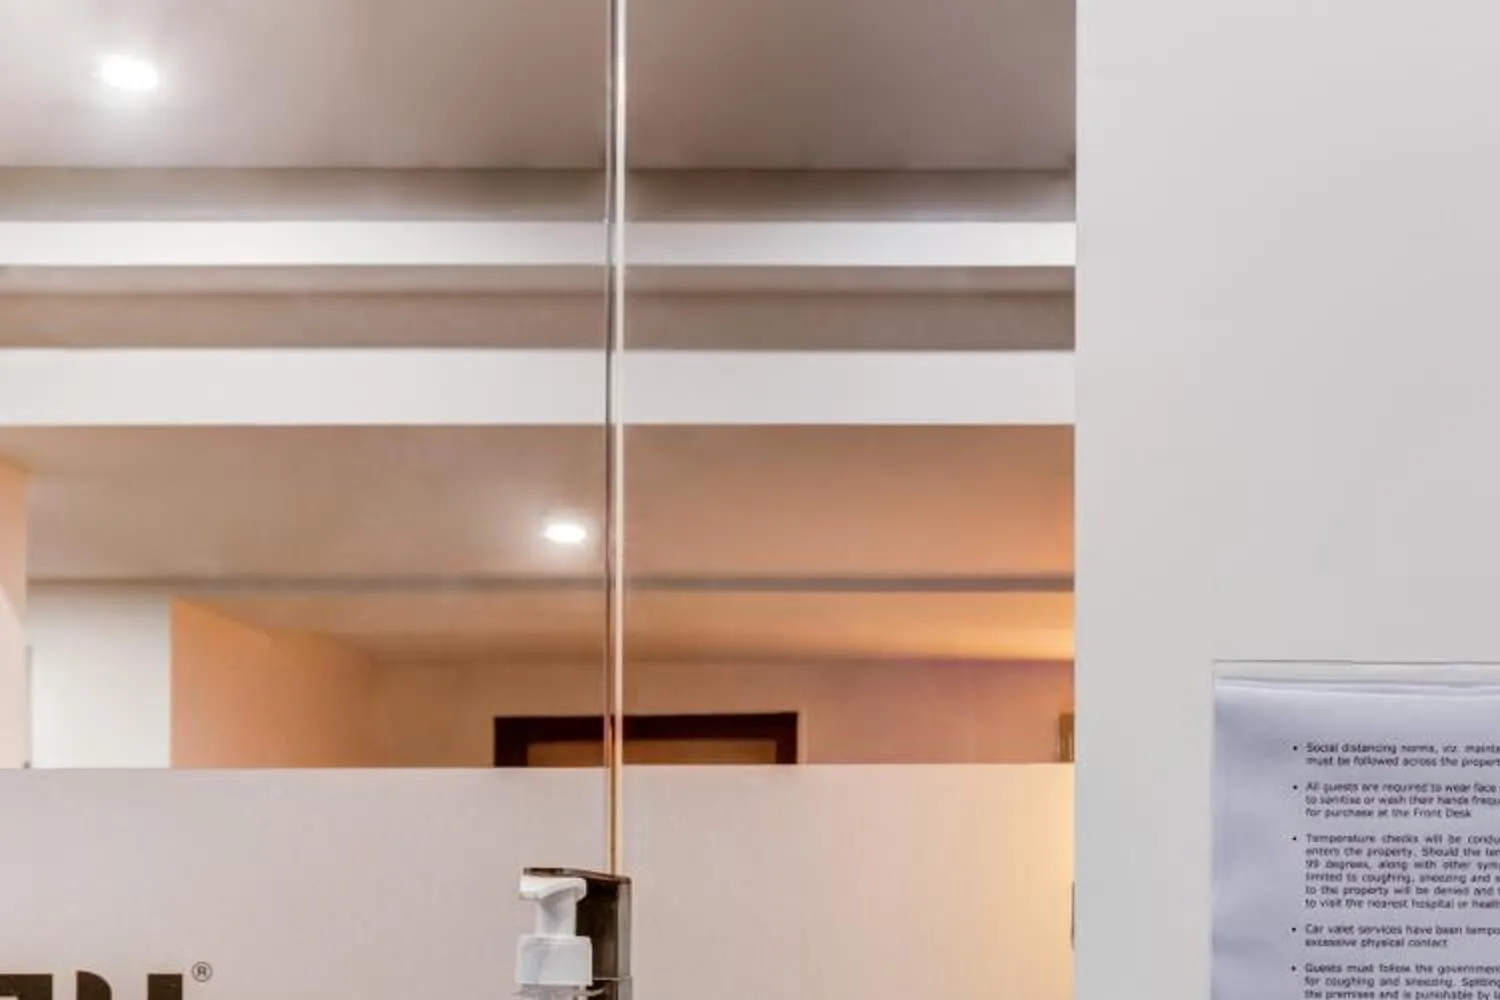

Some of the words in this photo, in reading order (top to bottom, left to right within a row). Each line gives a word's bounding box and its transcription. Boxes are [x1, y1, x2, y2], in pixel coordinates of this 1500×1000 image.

[1305, 742, 1339, 753] Social
[1340, 743, 1397, 756] distancing
[1336, 755, 1350, 766] be
[1352, 755, 1399, 767] followed
[1401, 758, 1438, 767] across
[1438, 756, 1458, 767] the
[1321, 781, 1359, 795] guests
[1360, 783, 1379, 792] are
[1429, 782, 1442, 793] to
[1472, 782, 1497, 793] face
[1304, 794, 1317, 805] to
[1362, 796, 1375, 805] or
[1377, 794, 1406, 805] wash
[1436, 795, 1469, 806] hands
[1304, 807, 1321, 818] for
[1323, 807, 1374, 820] purchase
[1376, 807, 1388, 818] at
[1390, 807, 1410, 818] the
[1412, 807, 1442, 818] Front
[1444, 807, 1471, 818] Desk
[1380, 833, 1419, 844] checks
[1446, 833, 1462, 844] be
[1343, 846, 1362, 857] the
[1420, 846, 1459, 857] Should
[1462, 846, 1481, 857] the
[1377, 858, 1408, 872] along
[1441, 859, 1471, 870] other
[1469, 872, 1490, 883] and
[1304, 884, 1317, 895] to
[1319, 884, 1338, 895] the
[1341, 884, 1389, 898] property
[1414, 885, 1429, 896] be
[1472, 885, 1494, 896] and
[1304, 897, 1317, 908] to
[1344, 897, 1364, 908] the
[1303, 923, 1324, 934] Car
[1359, 937, 1405, 950] physical
[1406, 937, 1448, 948] contact
[1413, 962, 1434, 974] the
[1303, 975, 1320, 986] for
[1324, 975, 1374, 989] coughing
[1378, 976, 1400, 987] and
[1303, 988, 1322, 999] the
[1377, 988, 1399, 1000] and
